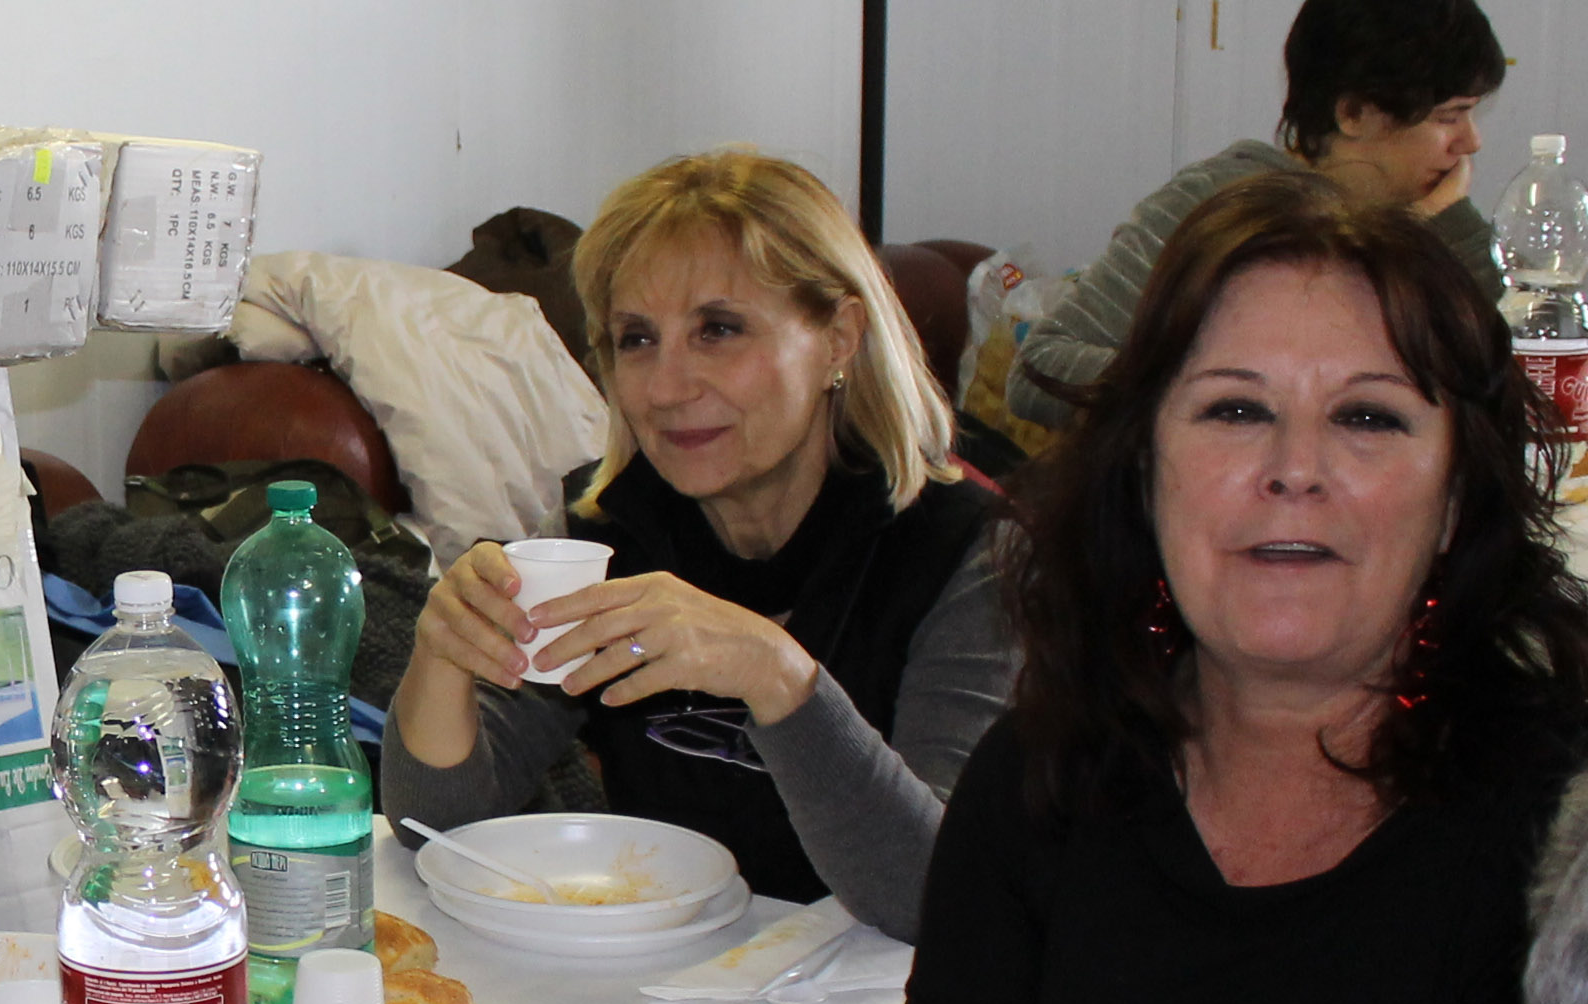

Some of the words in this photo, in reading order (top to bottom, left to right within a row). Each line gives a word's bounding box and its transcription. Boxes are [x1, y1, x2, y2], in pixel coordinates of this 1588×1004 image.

[27, 186, 42, 201] 6.5
[68, 187, 86, 202] KGS
[28, 224, 35, 240] 6
[65, 224, 85, 239] KGS
[223, 220, 232, 228] 7
[202, 240, 213, 266] KGS
[218, 242, 229, 268] KGS
[181, 281, 191, 300] CM
[24, 298, 29, 313] 1
